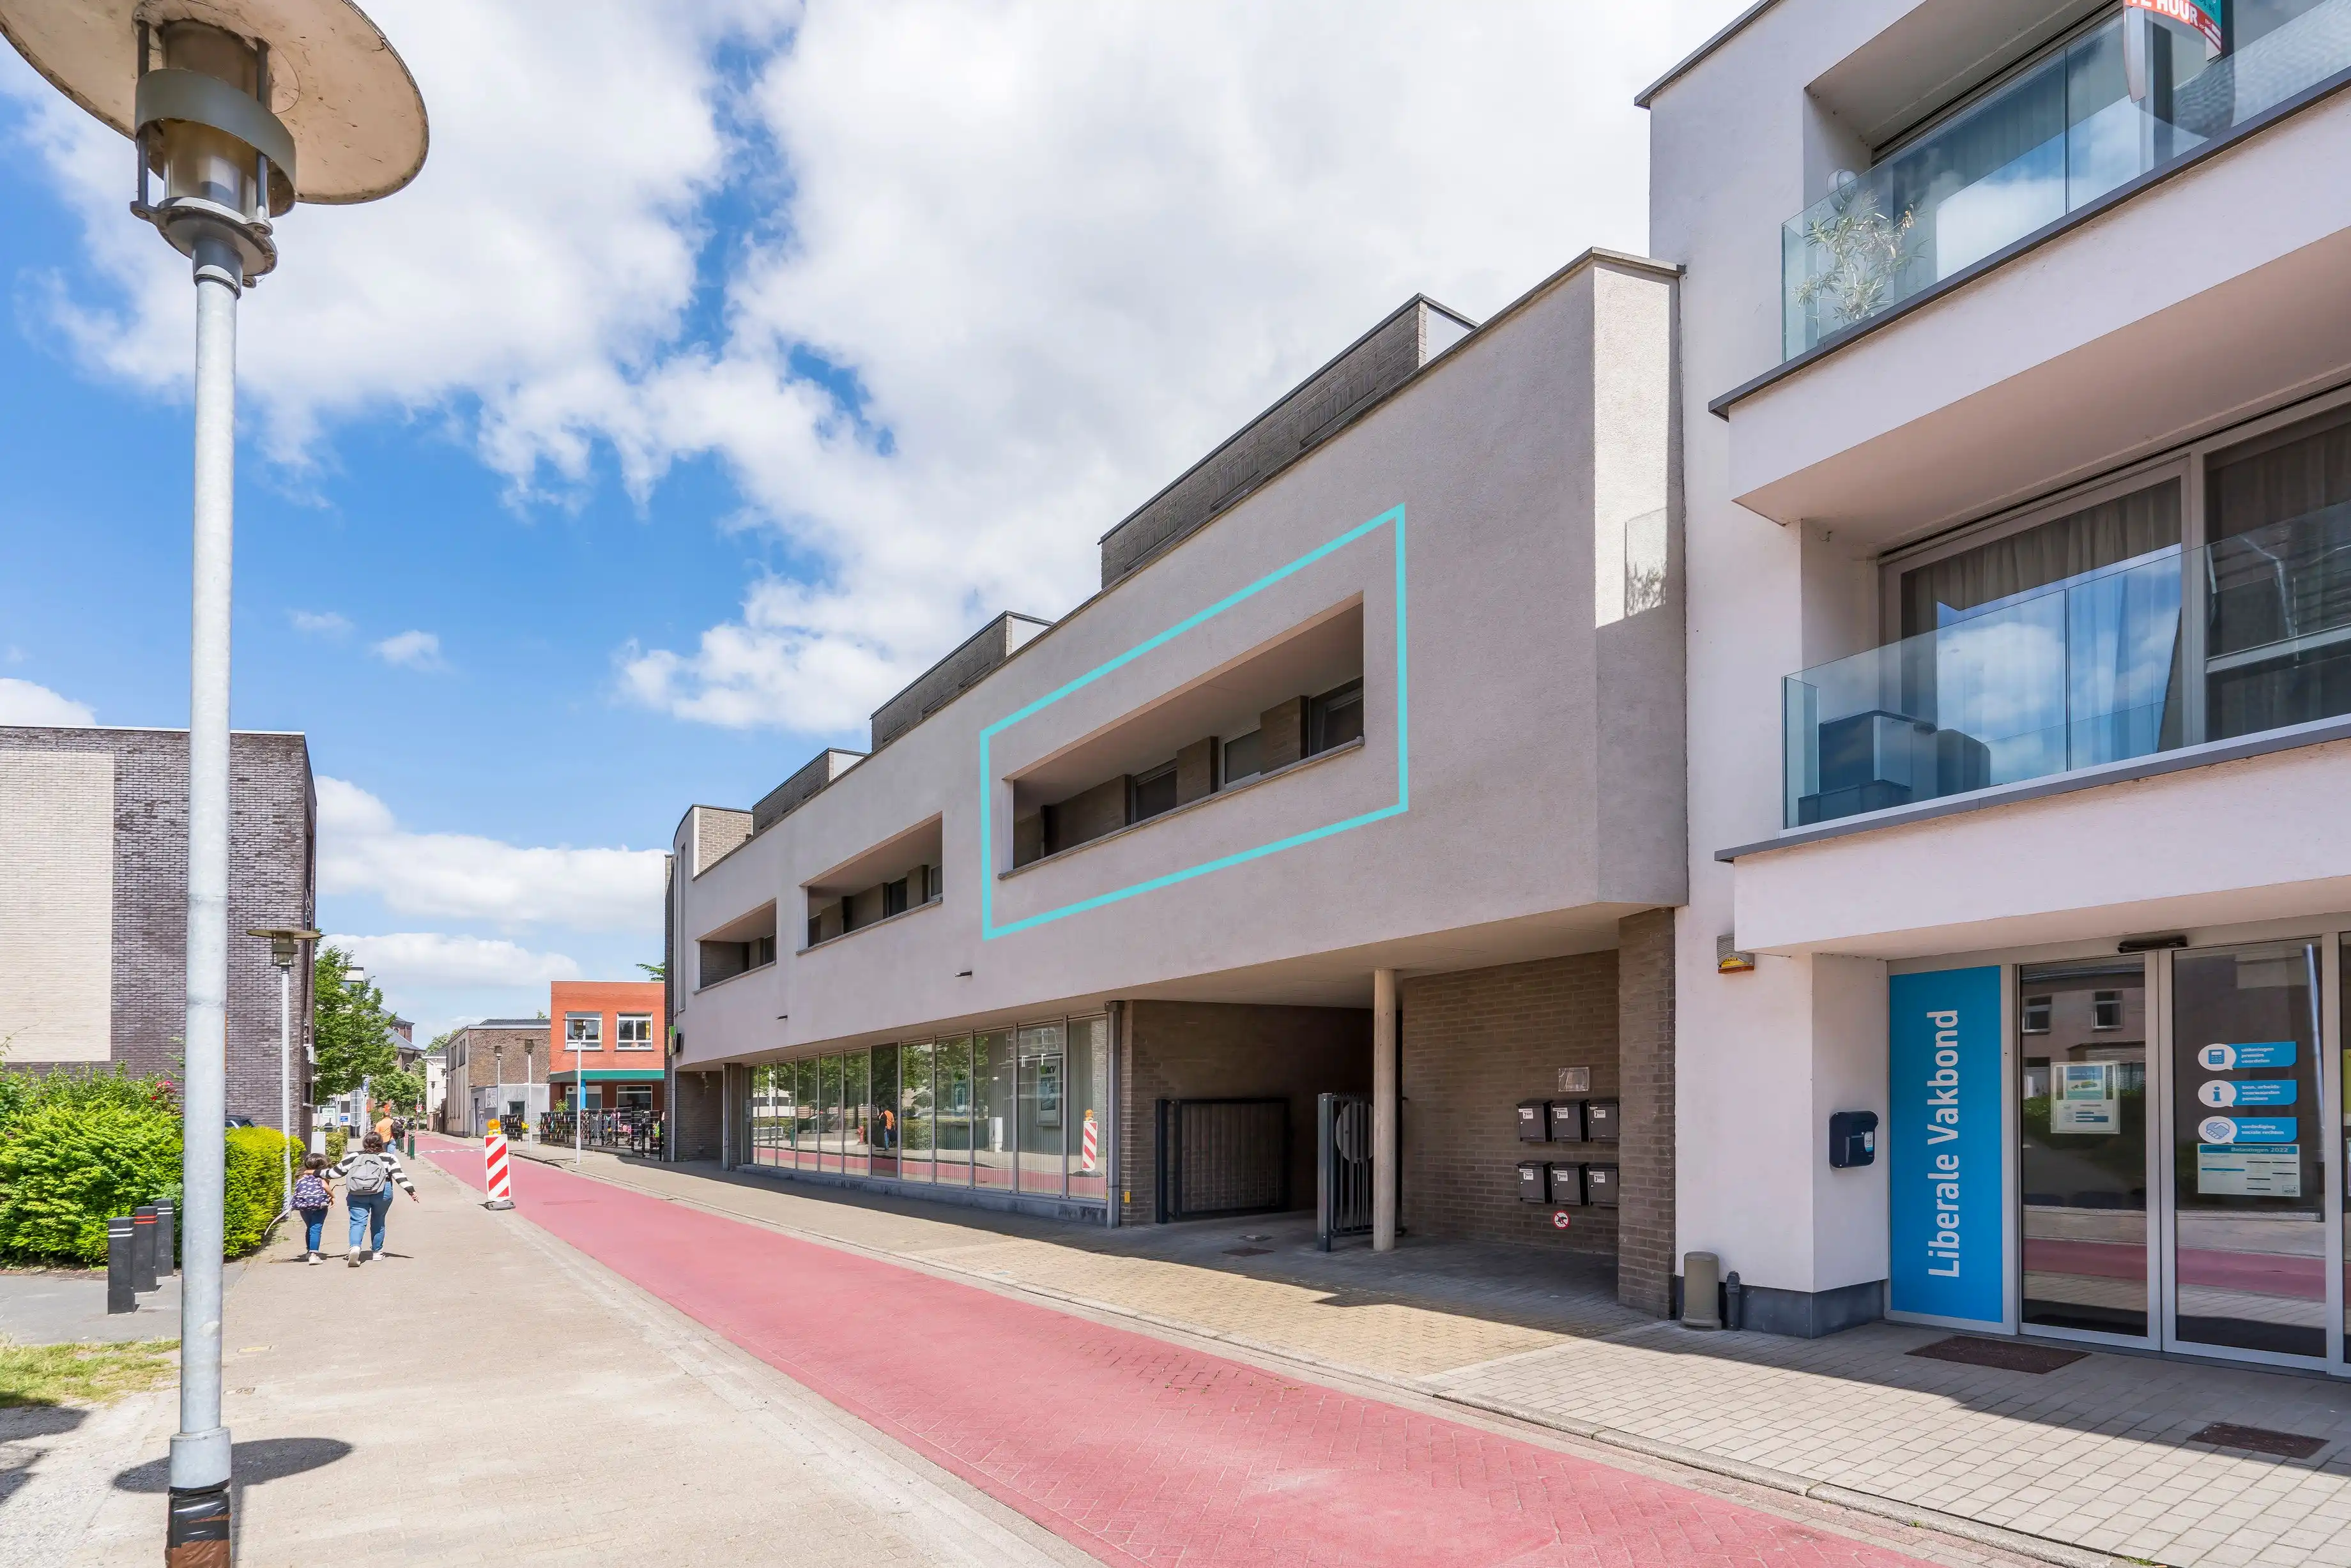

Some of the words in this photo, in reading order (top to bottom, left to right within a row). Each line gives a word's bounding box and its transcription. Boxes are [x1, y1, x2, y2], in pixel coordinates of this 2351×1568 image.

[1046, 1065, 1056, 1074] ACV
[1926, 1010, 1959, 1145] Vakbond
[1927, 1154, 1959, 1277] Liberale
